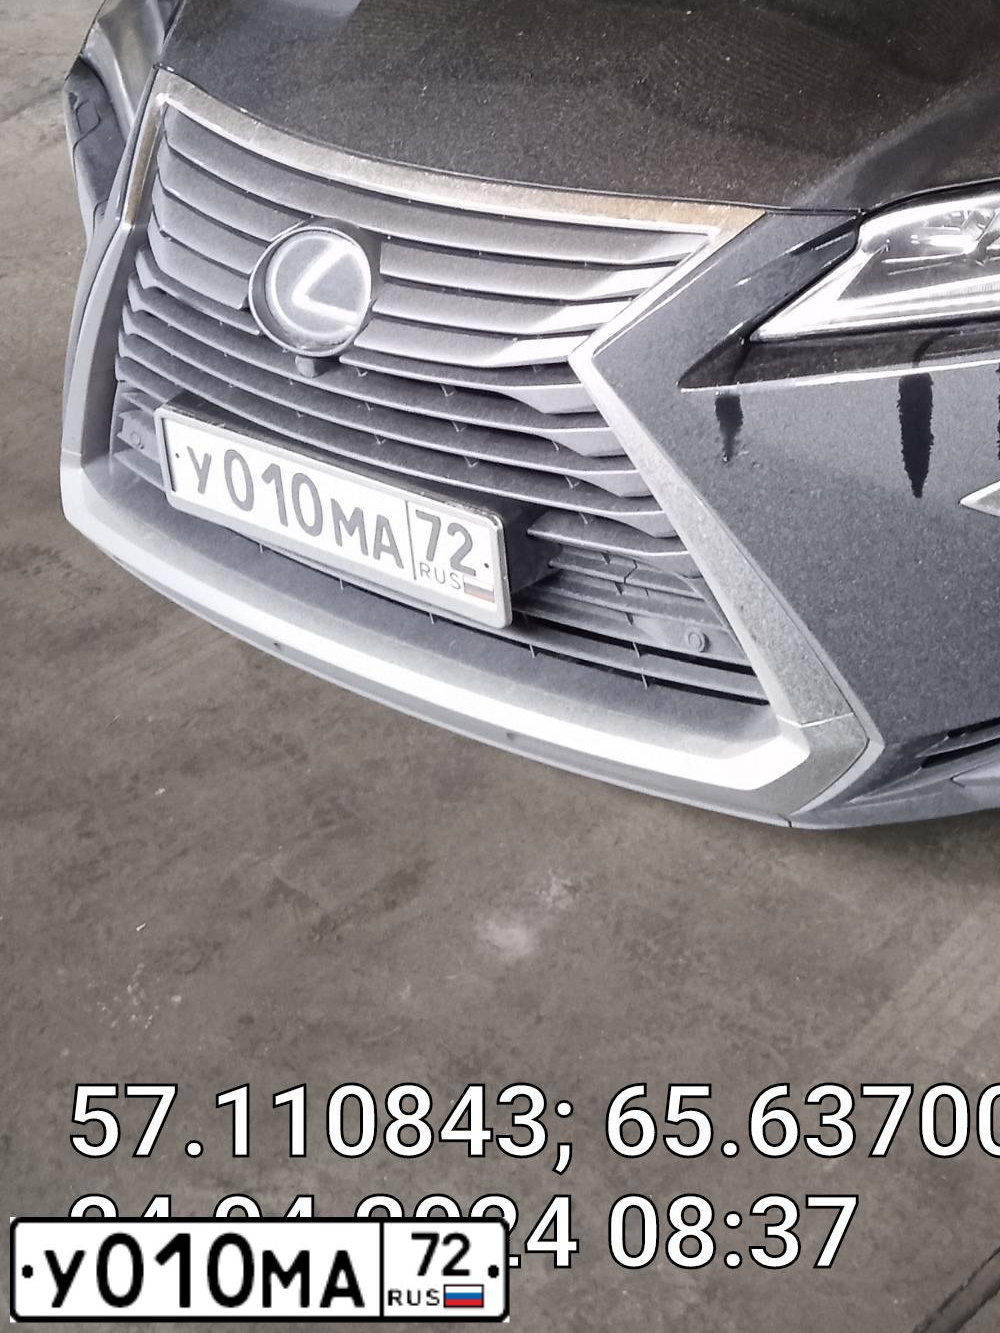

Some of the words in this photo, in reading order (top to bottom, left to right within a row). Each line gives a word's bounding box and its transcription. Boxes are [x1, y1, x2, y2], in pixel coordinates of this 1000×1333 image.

[186, 445, 405, 570] У010МА
[415, 509, 478, 577] 72
[419, 561, 462, 591] RUS
